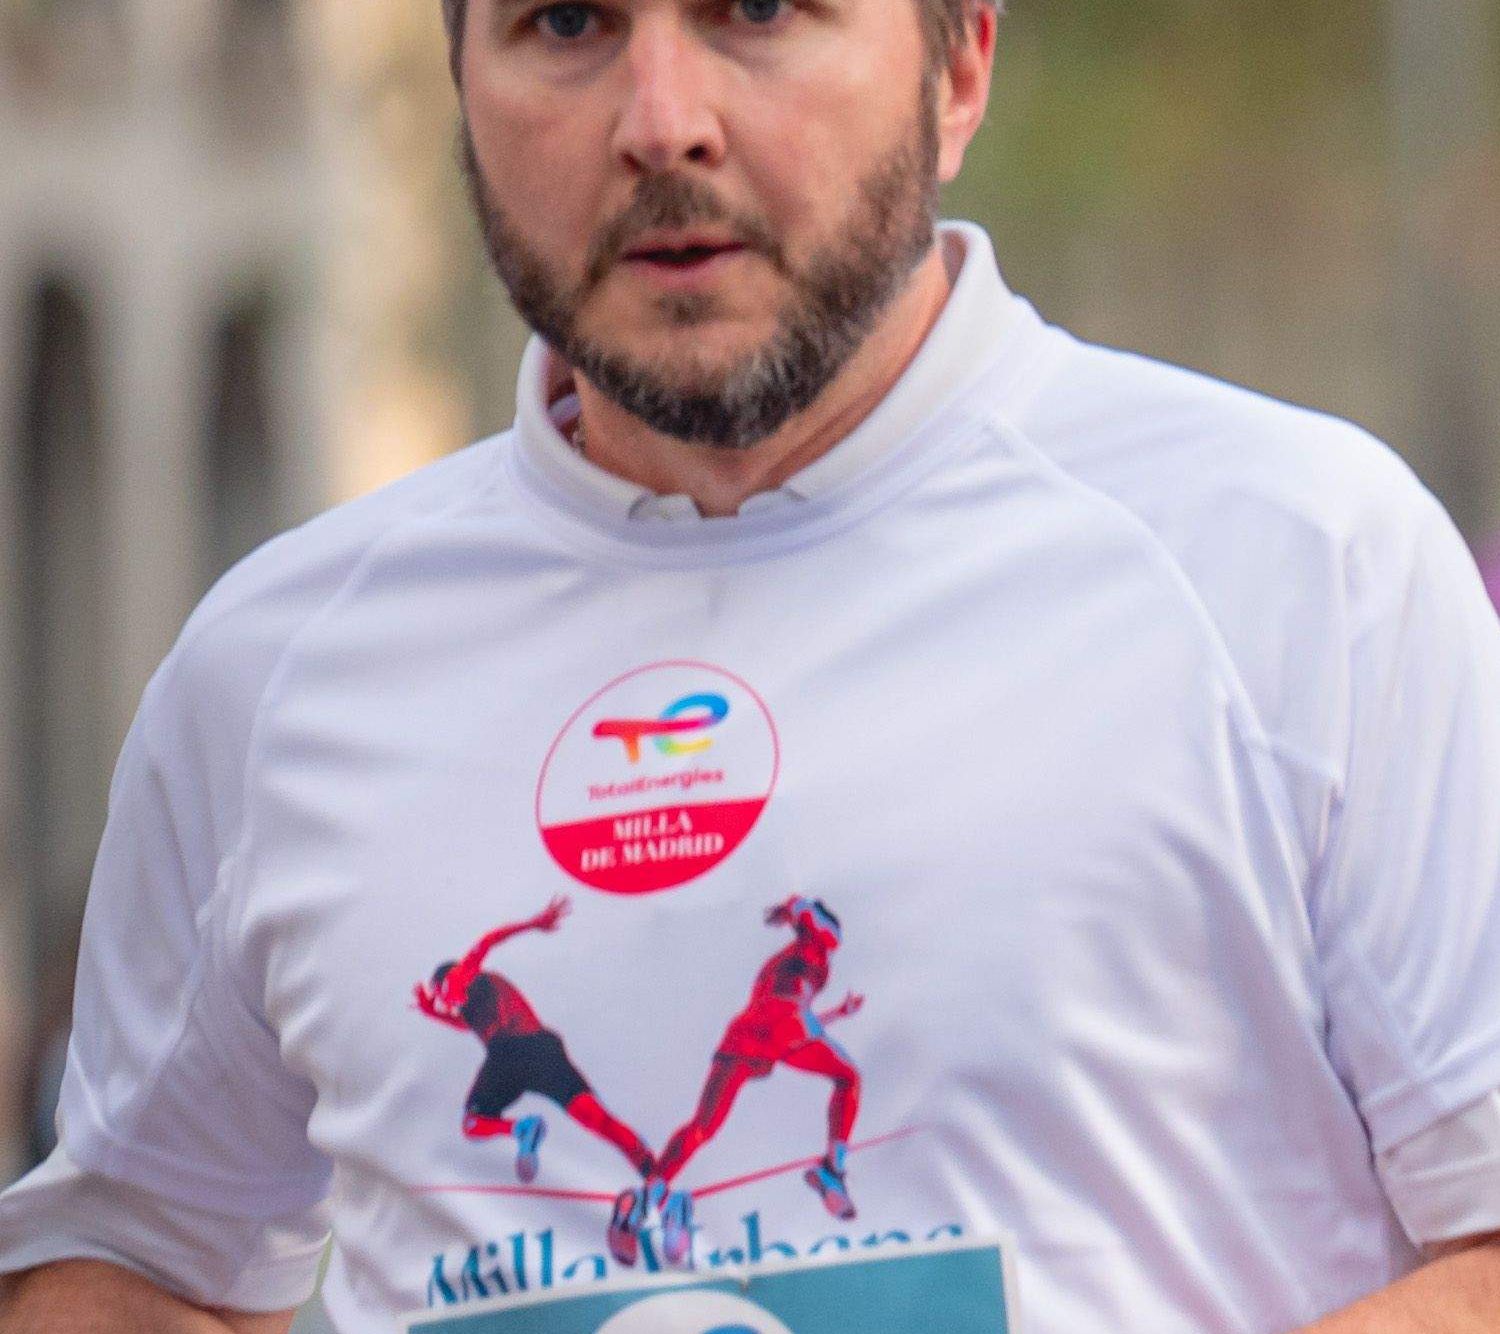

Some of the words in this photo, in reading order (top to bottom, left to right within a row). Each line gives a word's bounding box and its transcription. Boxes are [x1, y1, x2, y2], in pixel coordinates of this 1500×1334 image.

[613, 810, 692, 840] MILLA
[580, 846, 617, 872] DE
[622, 832, 725, 865] MADRID
